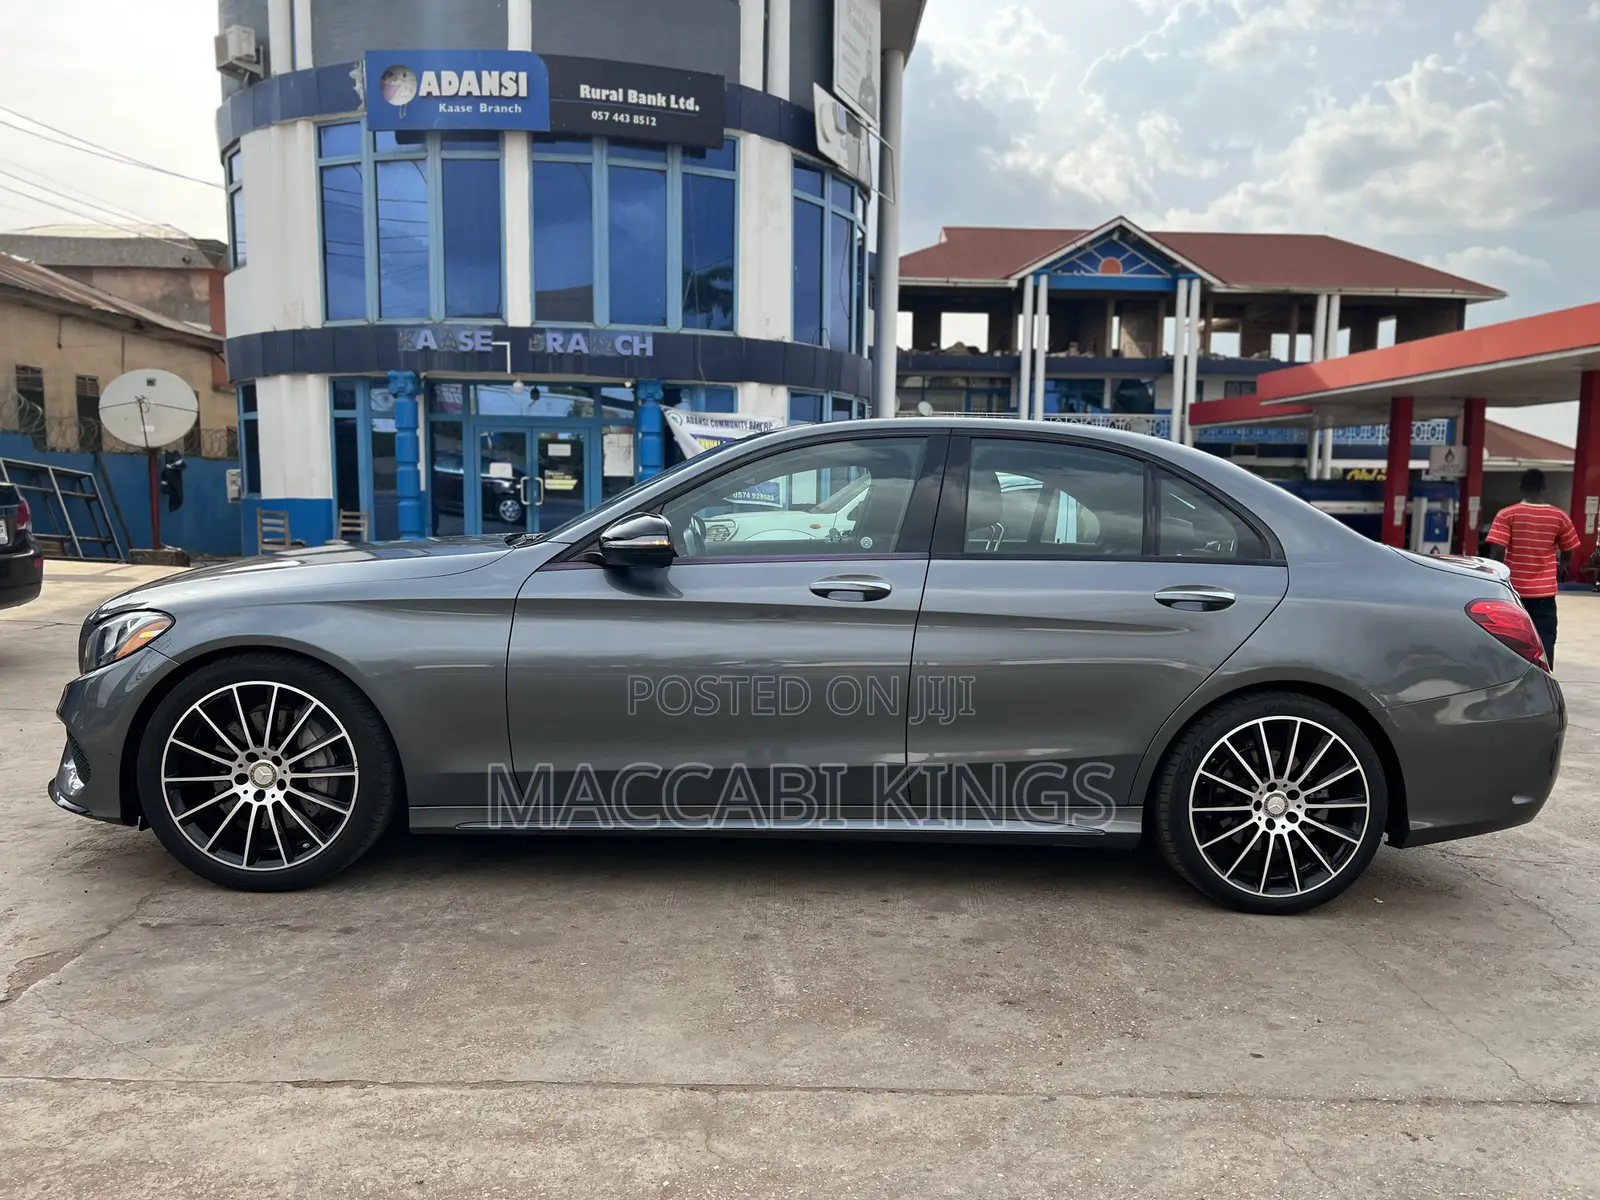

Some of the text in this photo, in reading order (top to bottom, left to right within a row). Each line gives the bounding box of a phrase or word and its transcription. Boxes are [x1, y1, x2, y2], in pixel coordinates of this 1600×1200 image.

[419, 71, 528, 97] ADANSI
[580, 84, 700, 111] Rural Bank Ltd.
[439, 102, 522, 113] Kaase Branch
[591, 110, 657, 127] 057 443 8512
[686, 415, 708, 427] ADANSI
[710, 419, 748, 430] COMMUNITY
